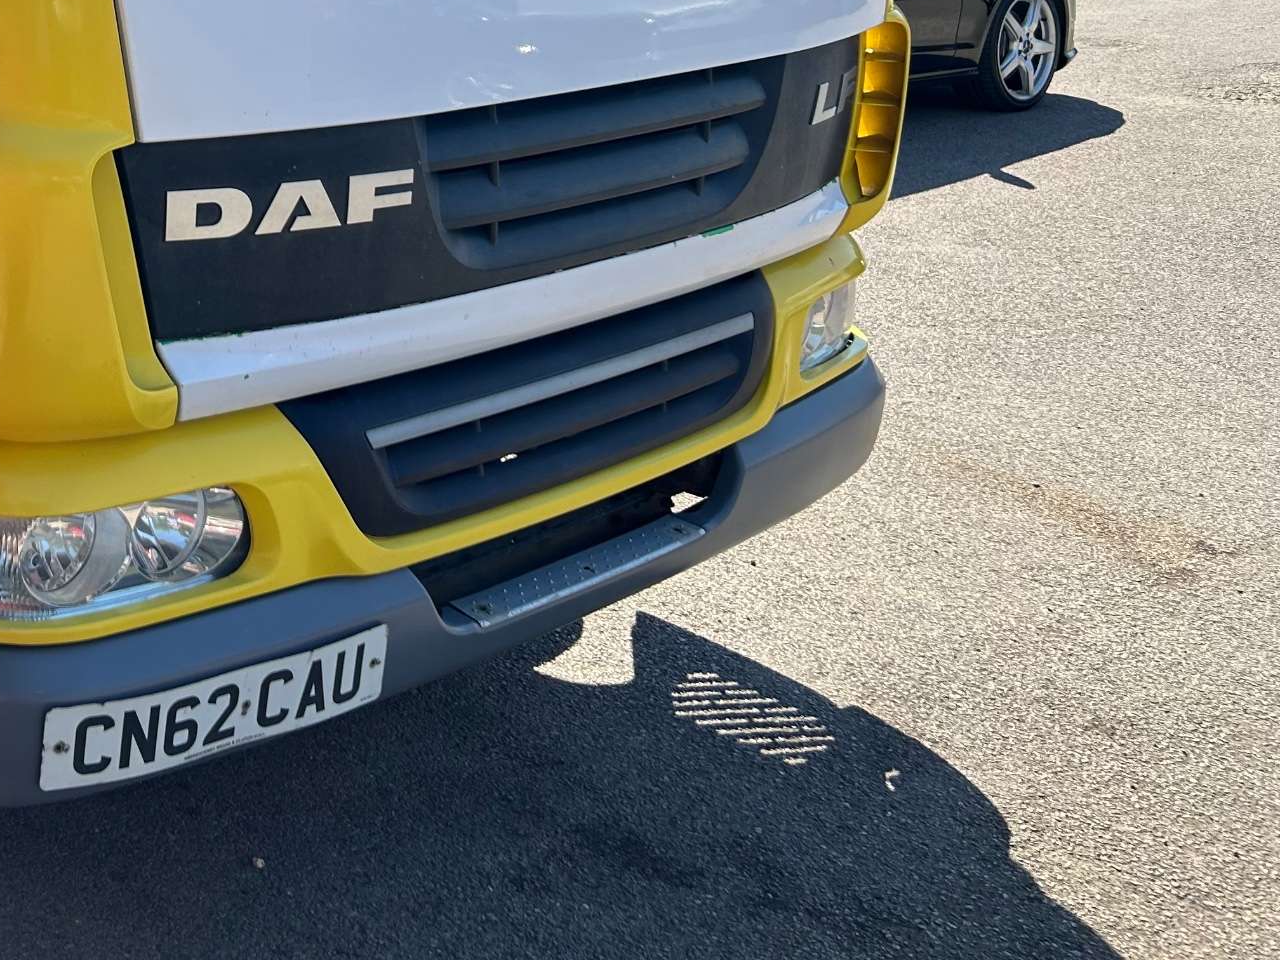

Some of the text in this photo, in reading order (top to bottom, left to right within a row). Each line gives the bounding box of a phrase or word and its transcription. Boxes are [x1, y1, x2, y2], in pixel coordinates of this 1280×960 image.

[165, 168, 415, 242] DAF
[72, 642, 366, 776] CN62 CAU
